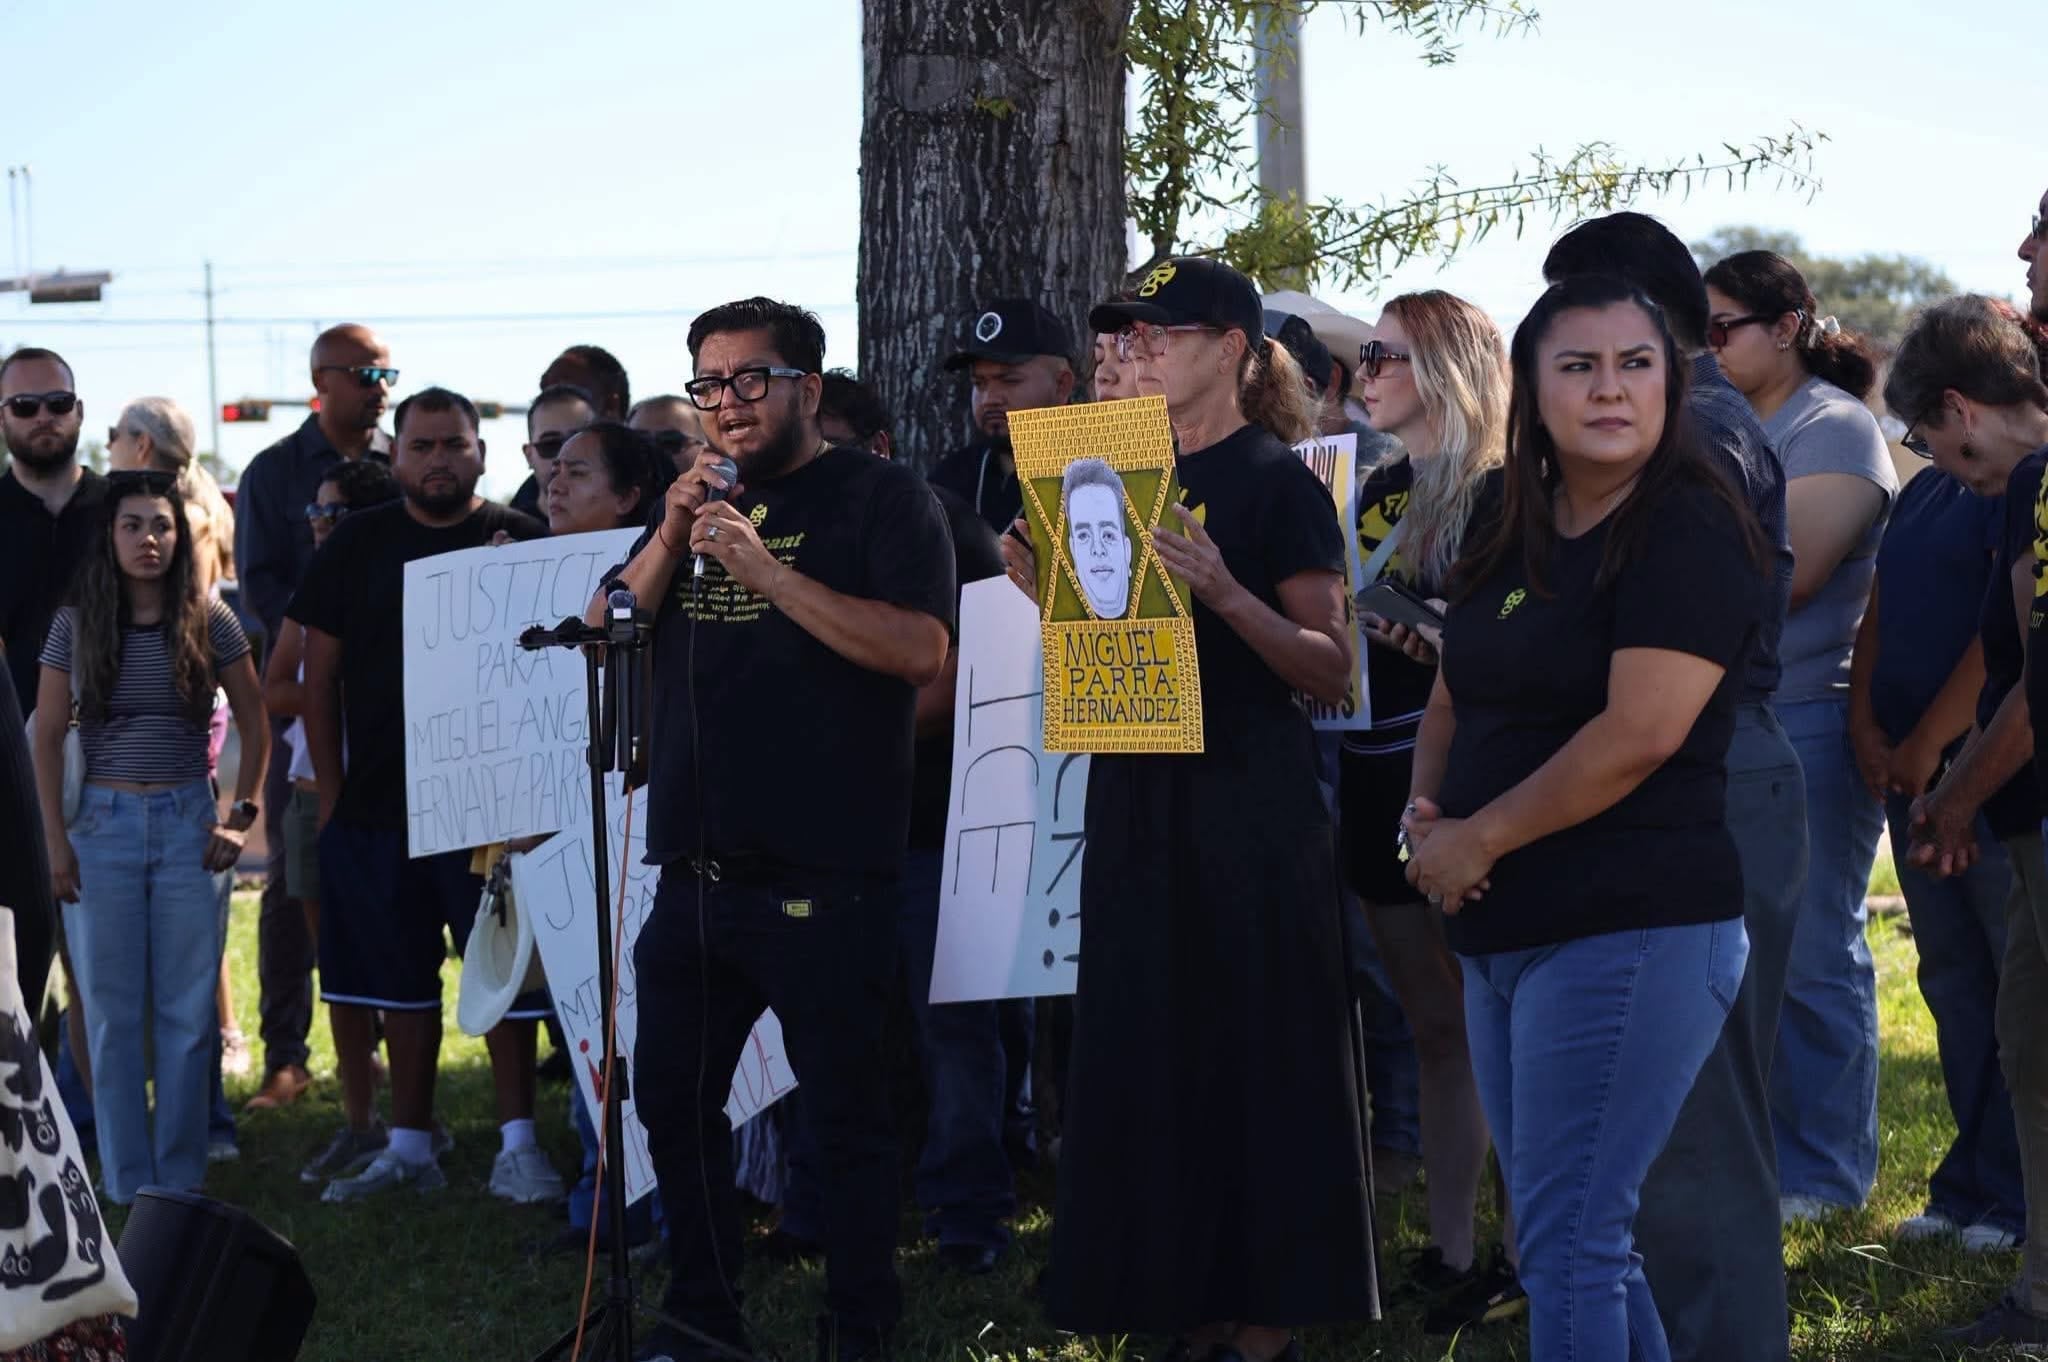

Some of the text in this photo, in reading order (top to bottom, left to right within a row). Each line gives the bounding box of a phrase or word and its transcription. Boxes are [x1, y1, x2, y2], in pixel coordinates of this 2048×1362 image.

[476, 640, 554, 695] PARA
[1064, 630, 1170, 668] MIGUEL
[412, 687, 590, 767] MIGUEL-ANG
[1063, 698, 1180, 724] HERNANDEZ
